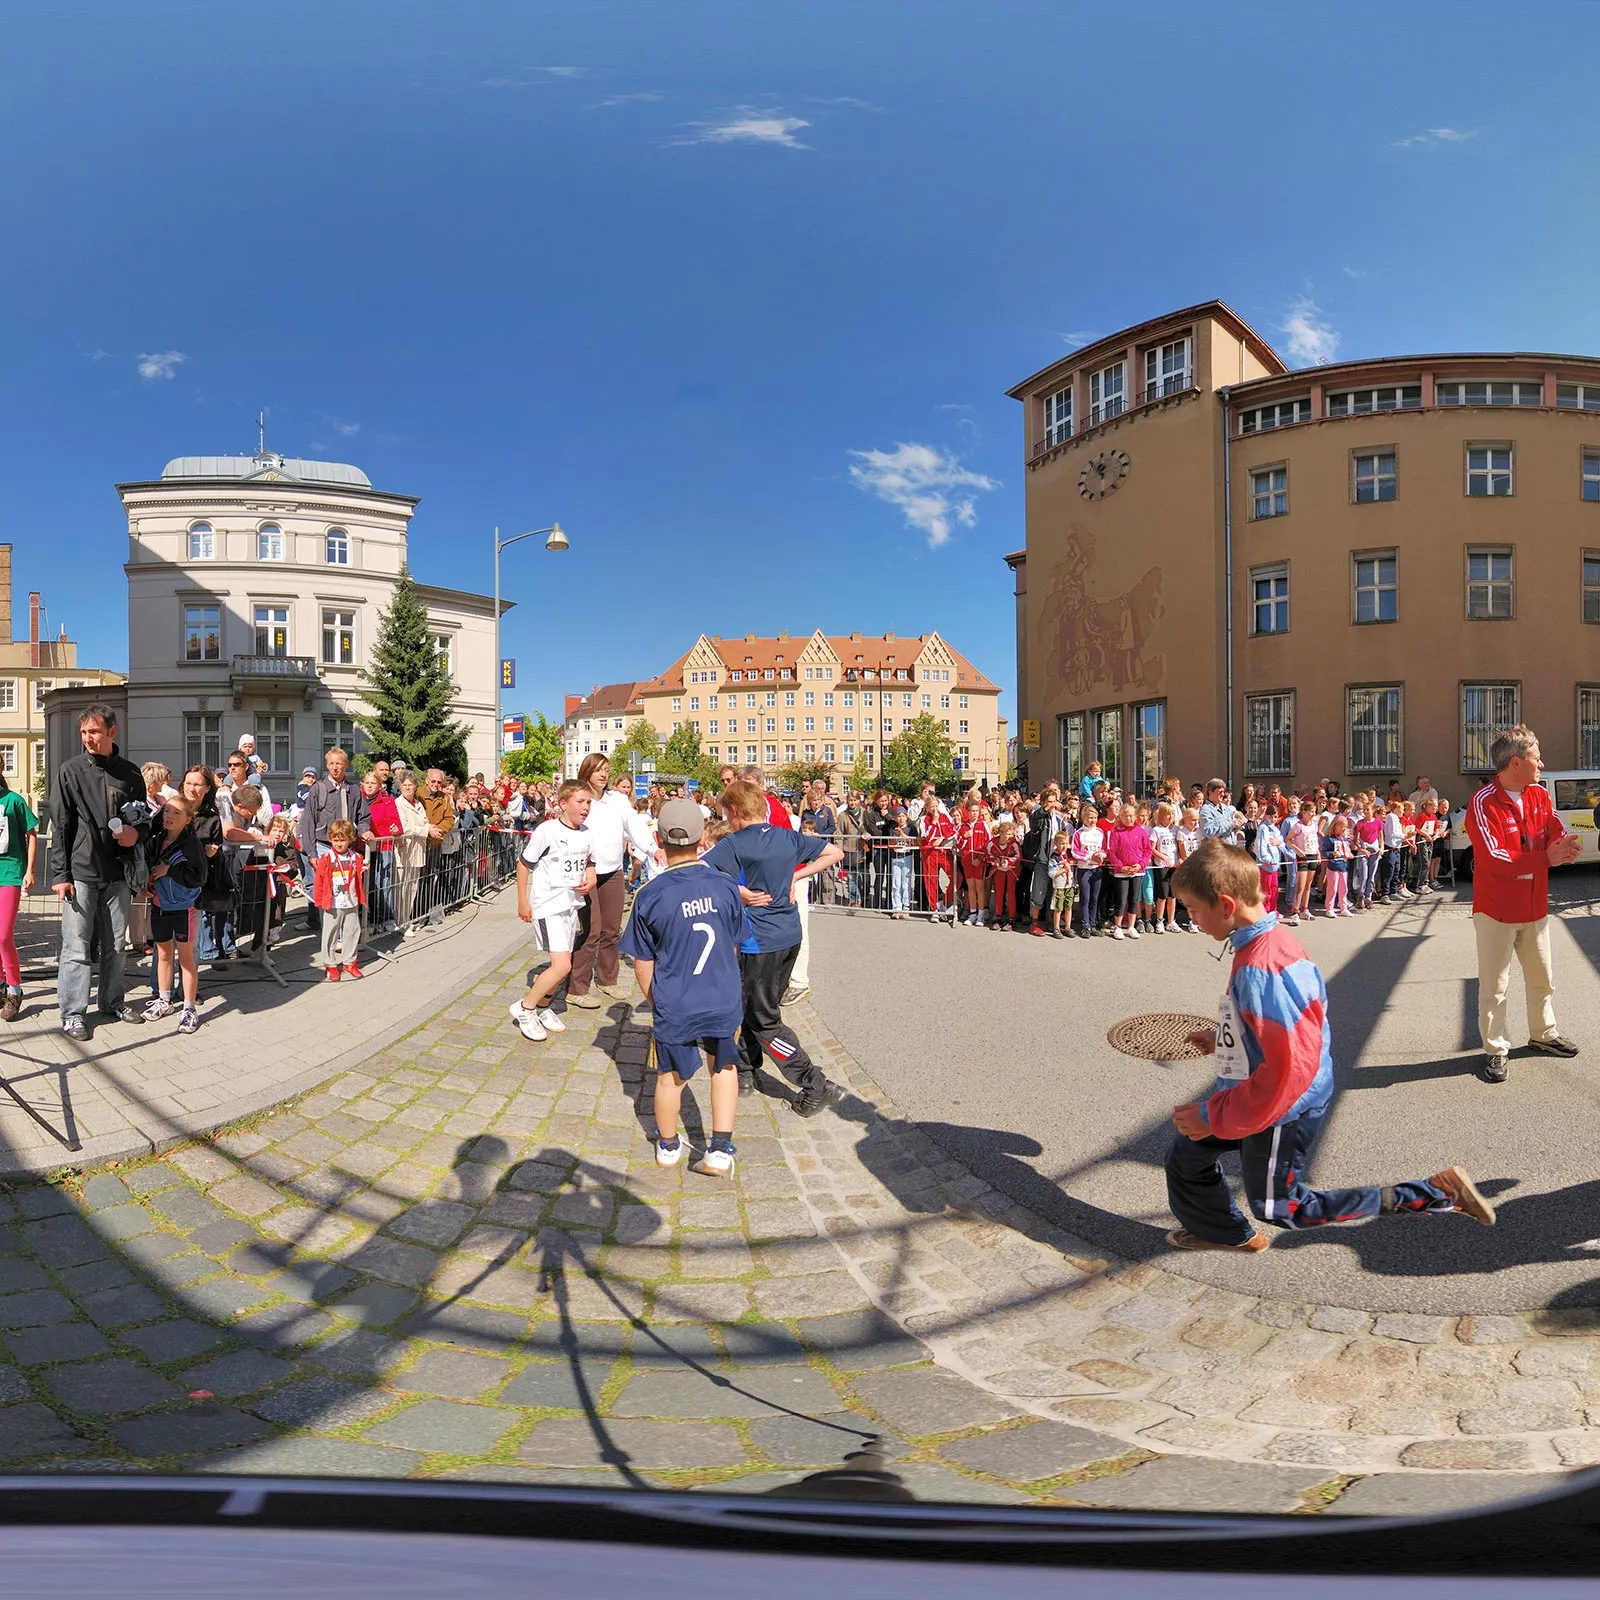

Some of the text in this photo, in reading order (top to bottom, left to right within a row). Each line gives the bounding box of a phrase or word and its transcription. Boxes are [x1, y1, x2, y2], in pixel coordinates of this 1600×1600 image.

[503, 661, 511, 685] KKH
[681, 897, 718, 918] RAUL
[692, 922, 716, 975] 7
